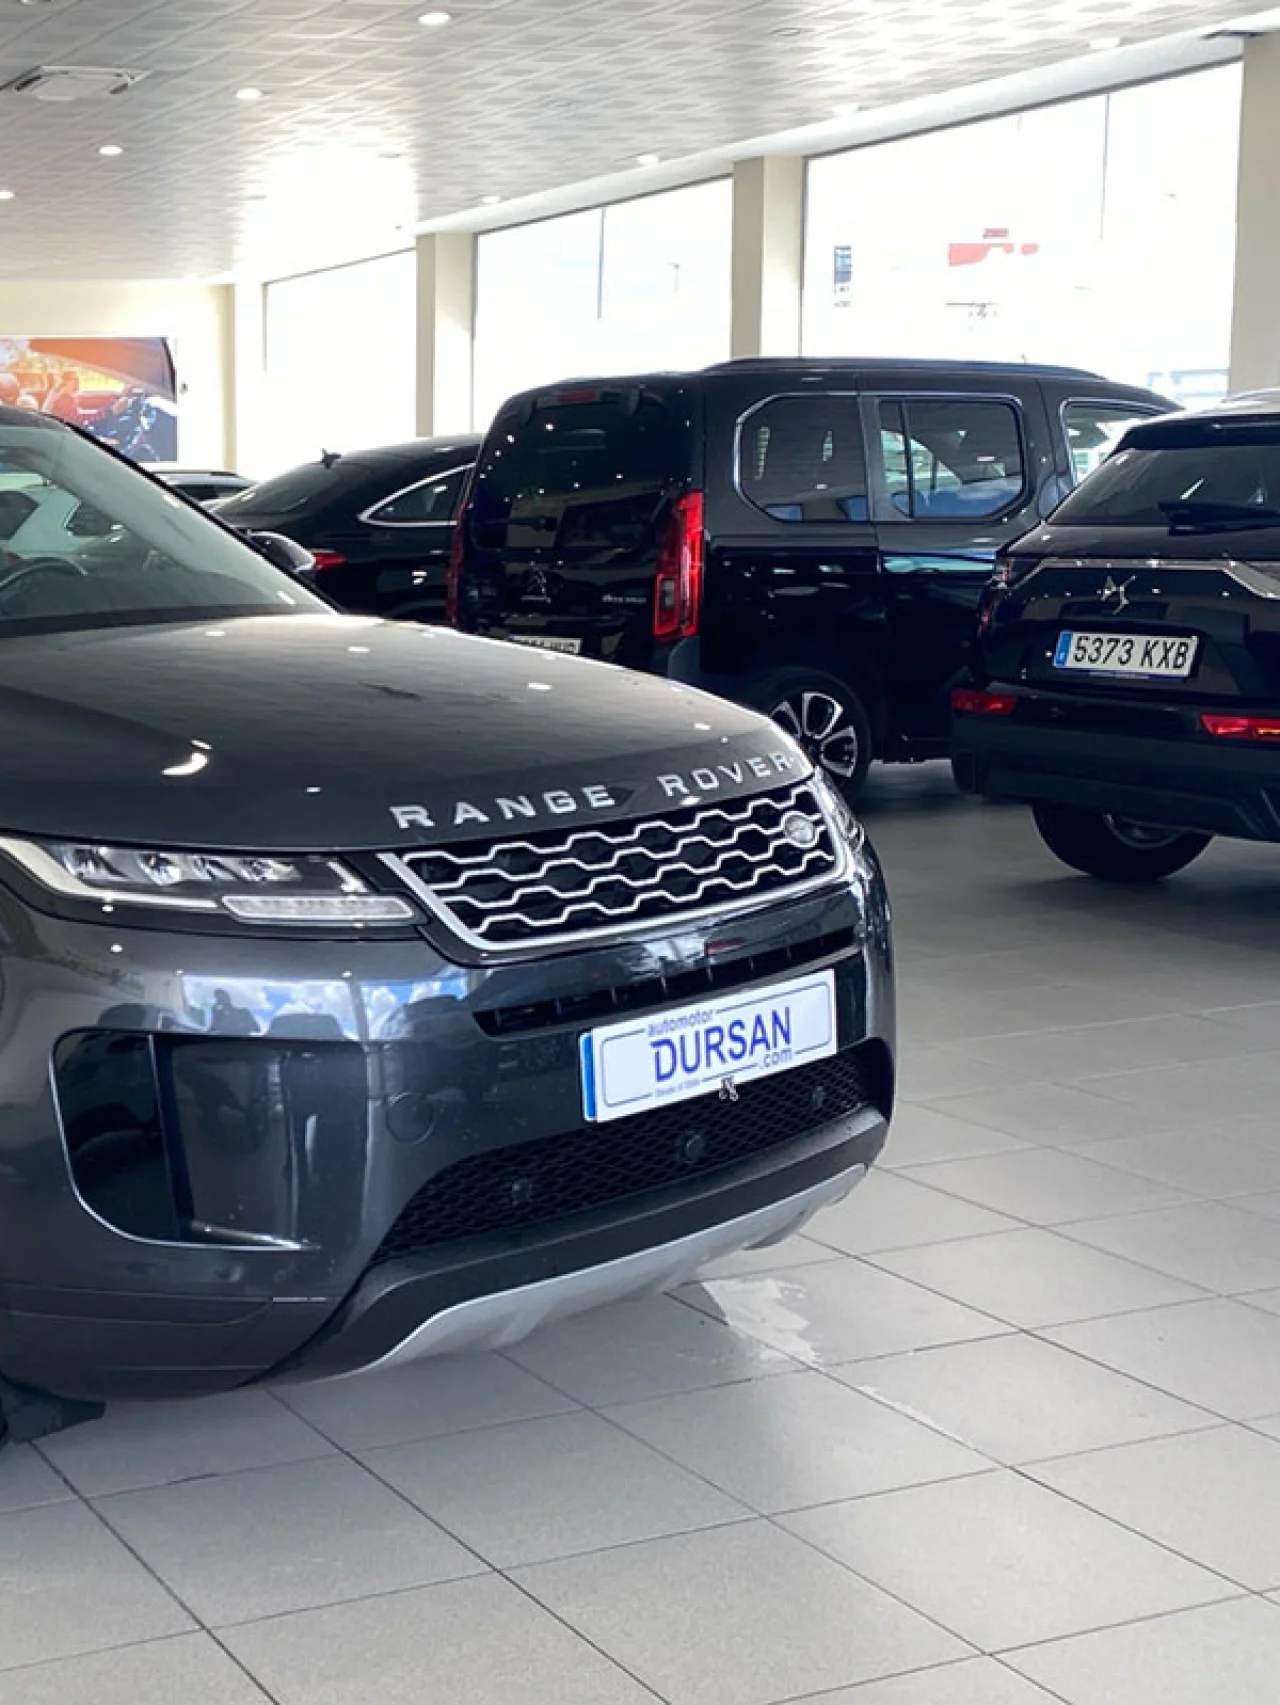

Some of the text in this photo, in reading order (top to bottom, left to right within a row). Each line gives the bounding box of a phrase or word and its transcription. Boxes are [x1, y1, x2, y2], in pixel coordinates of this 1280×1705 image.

[1073, 635, 1189, 668] 5373 KXB
[388, 752, 792, 829] RANGE ROVER
[649, 1009, 713, 1036] automotor
[650, 1007, 791, 1081] DURSAN
[760, 1049, 793, 1069] .com
